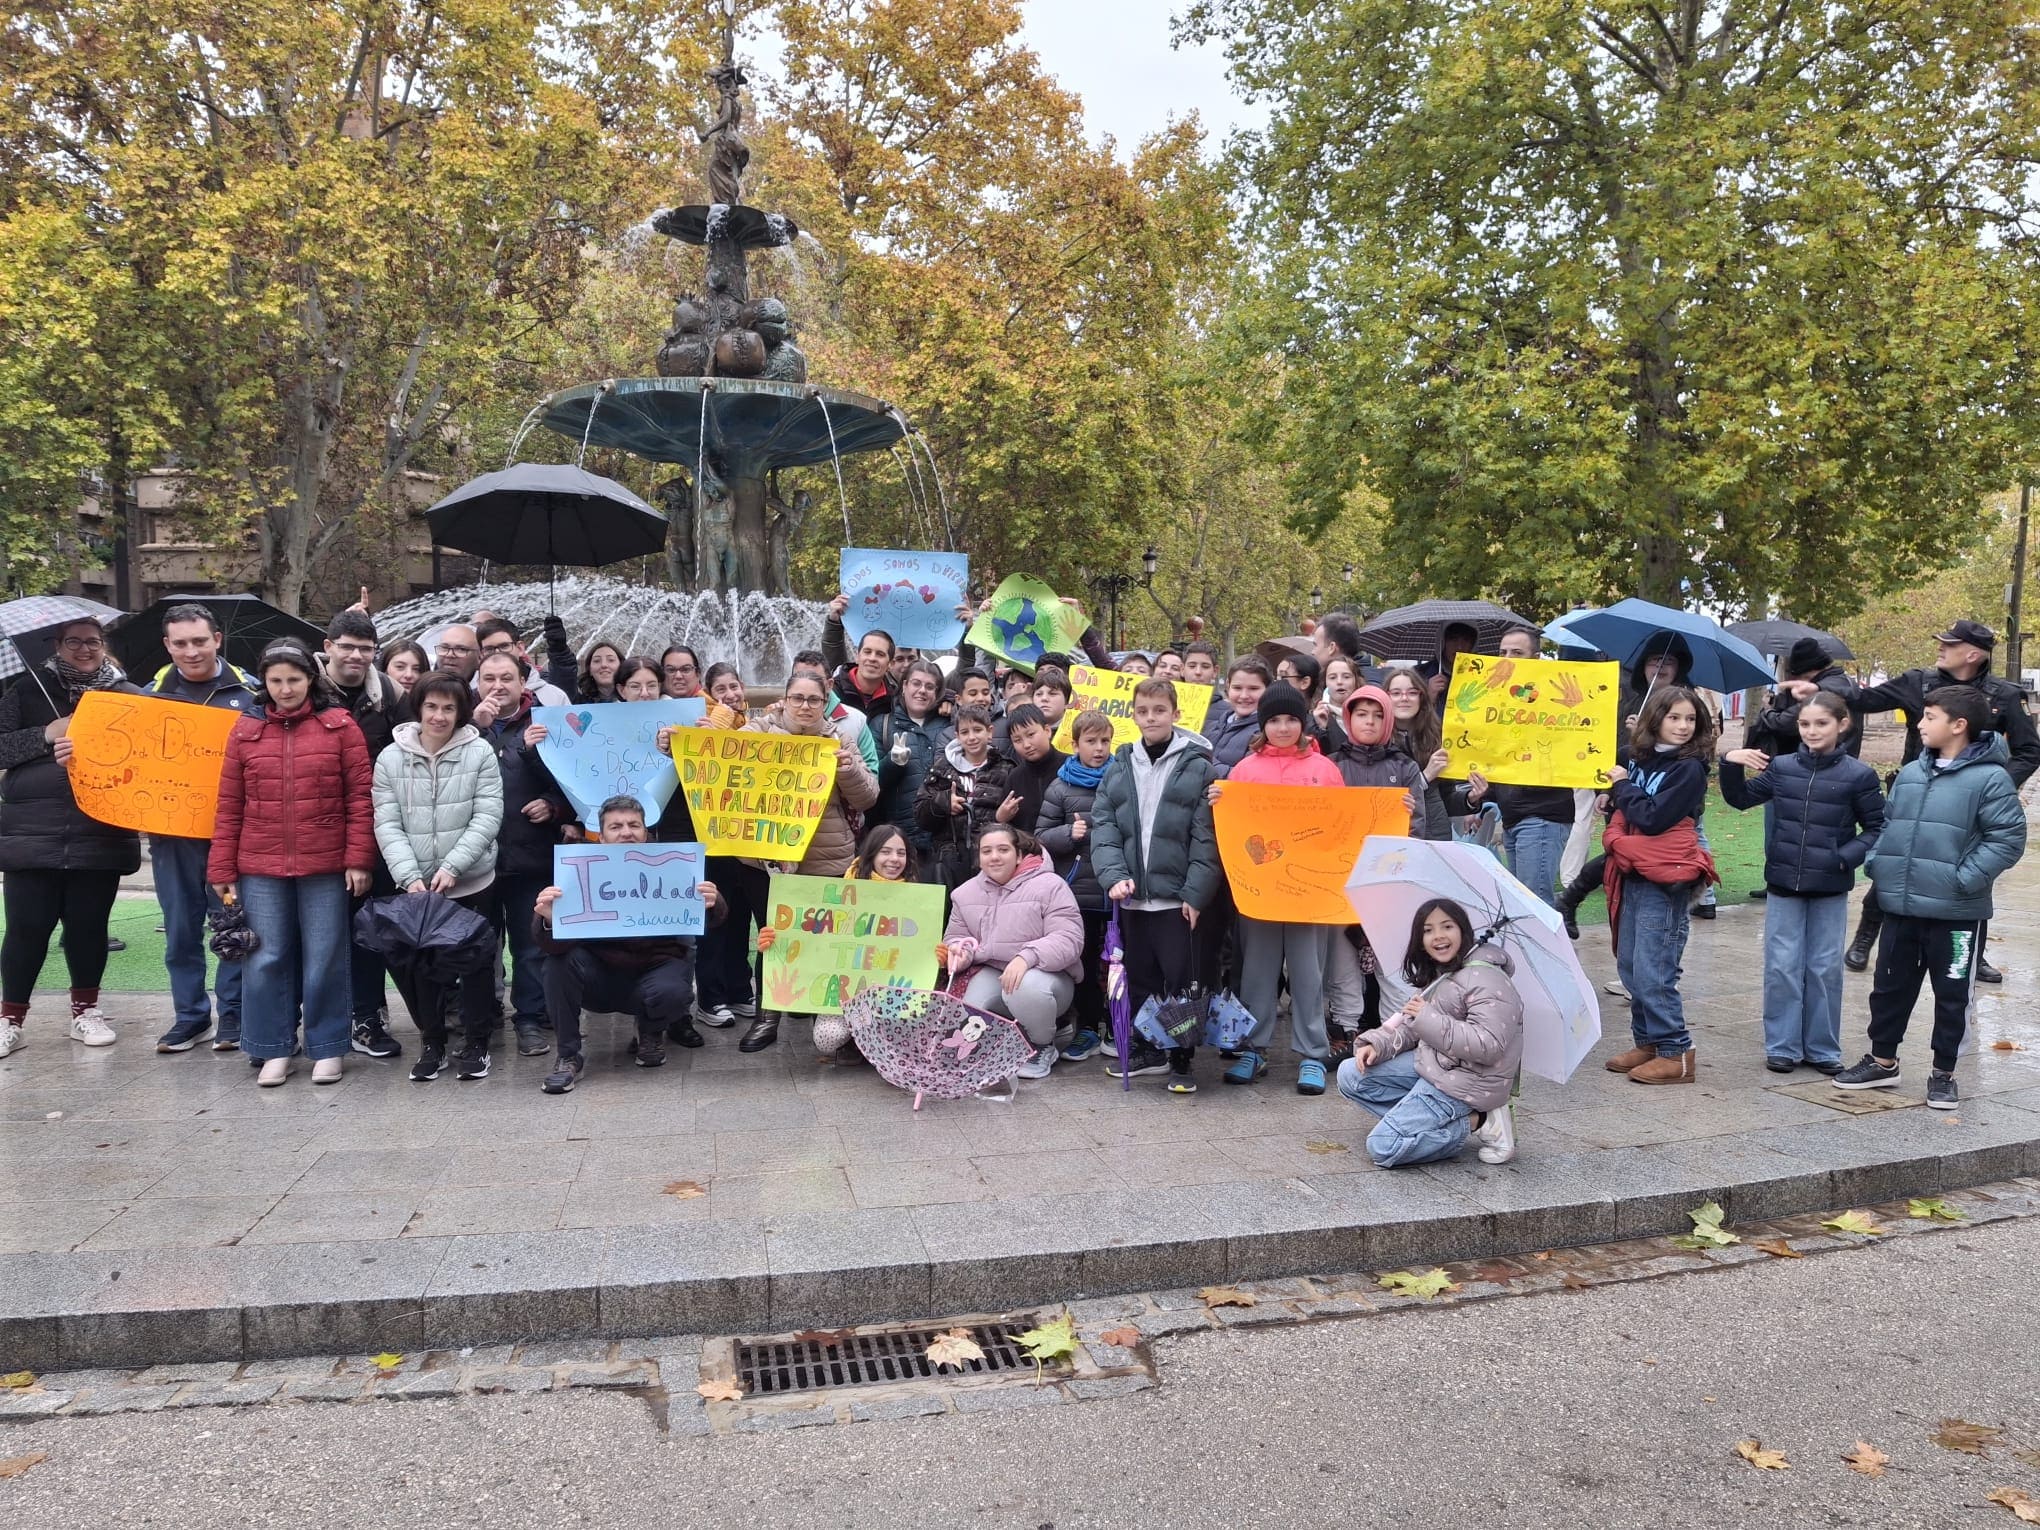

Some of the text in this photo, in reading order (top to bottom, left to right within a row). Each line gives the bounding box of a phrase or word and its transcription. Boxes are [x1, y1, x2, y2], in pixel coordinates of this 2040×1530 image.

[1114, 675, 1134, 691] DE
[85, 699, 136, 767] 3
[683, 735, 716, 758] LA
[683, 758, 828, 793] DAD ES SOLO
[720, 788, 804, 819] PALABRA
[822, 883, 857, 905] LA
[768, 938, 900, 970] NO TIENE
